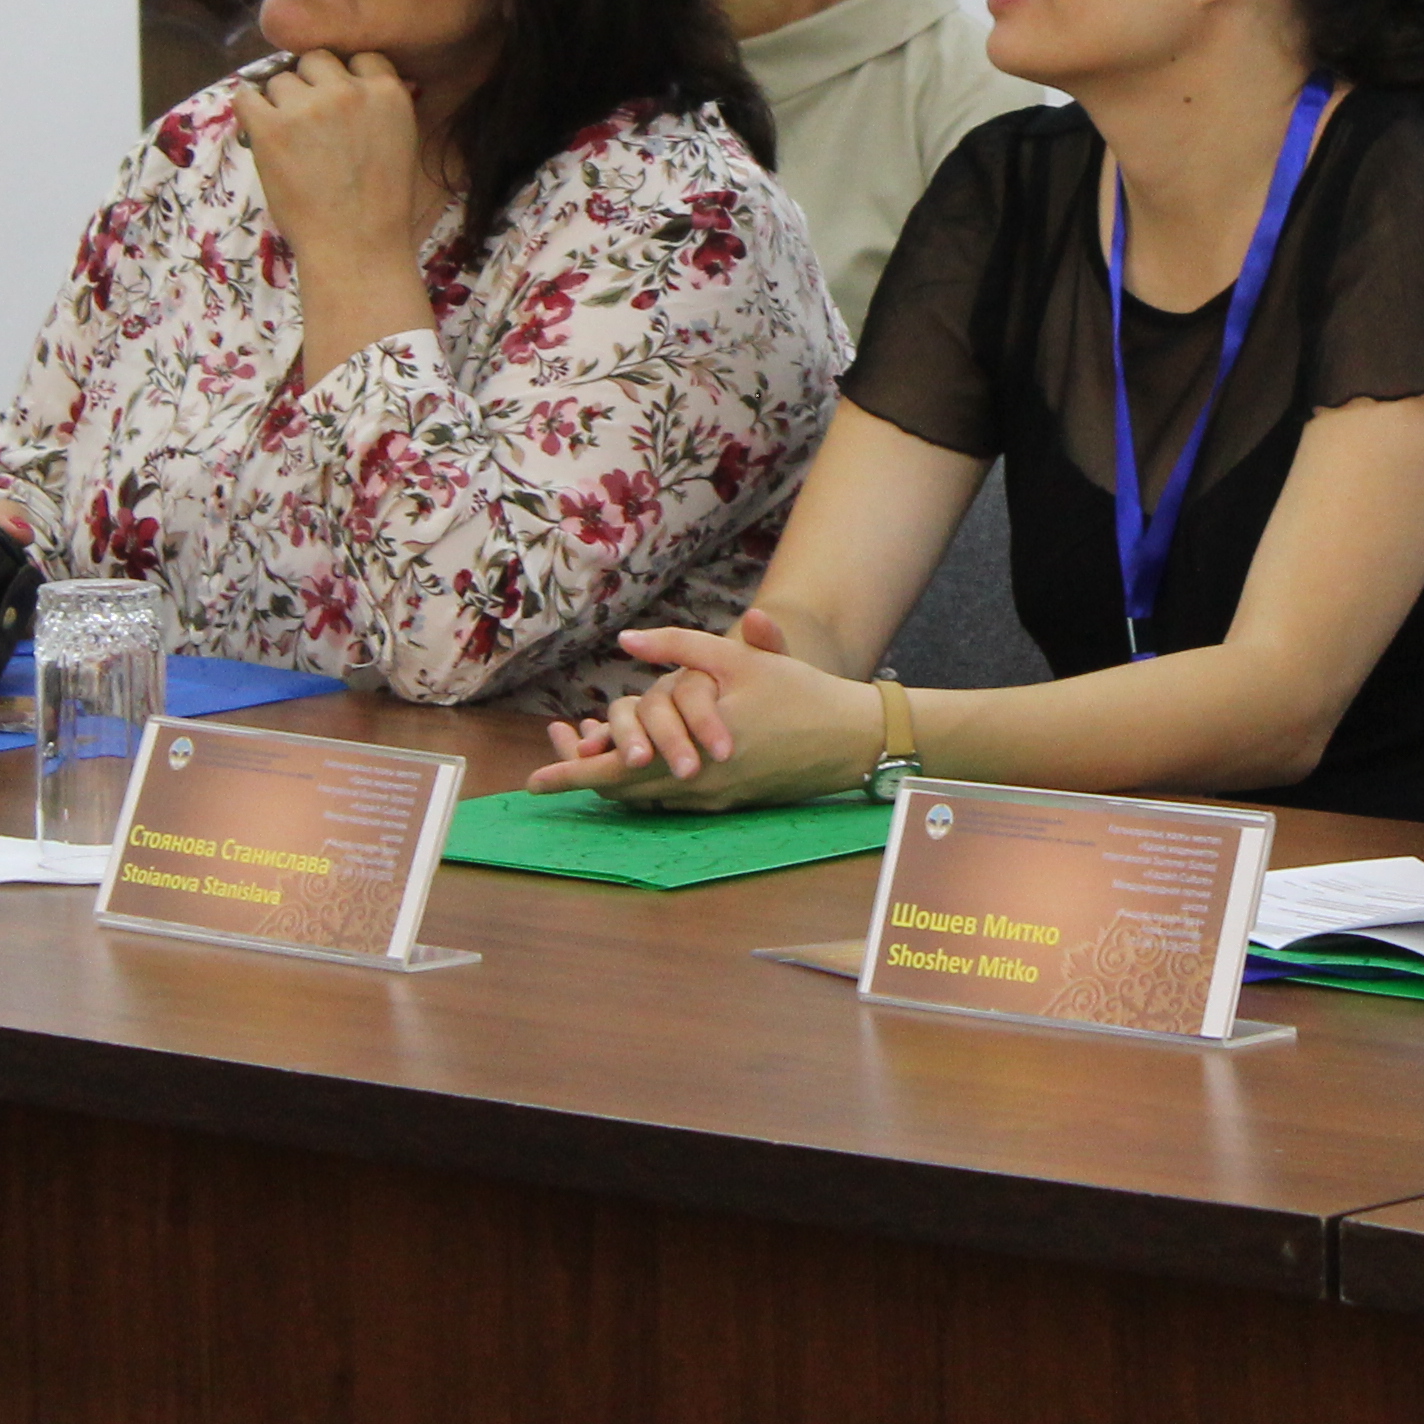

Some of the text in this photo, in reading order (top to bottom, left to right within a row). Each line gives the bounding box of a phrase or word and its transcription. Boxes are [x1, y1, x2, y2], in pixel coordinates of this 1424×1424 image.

[130, 825, 330, 875] Стоянова Станислава
[123, 863, 282, 905] Stoianova Stanislava
[890, 902, 1061, 946] Шошев Митко
[887, 943, 1039, 983] Shoshev Mitko
